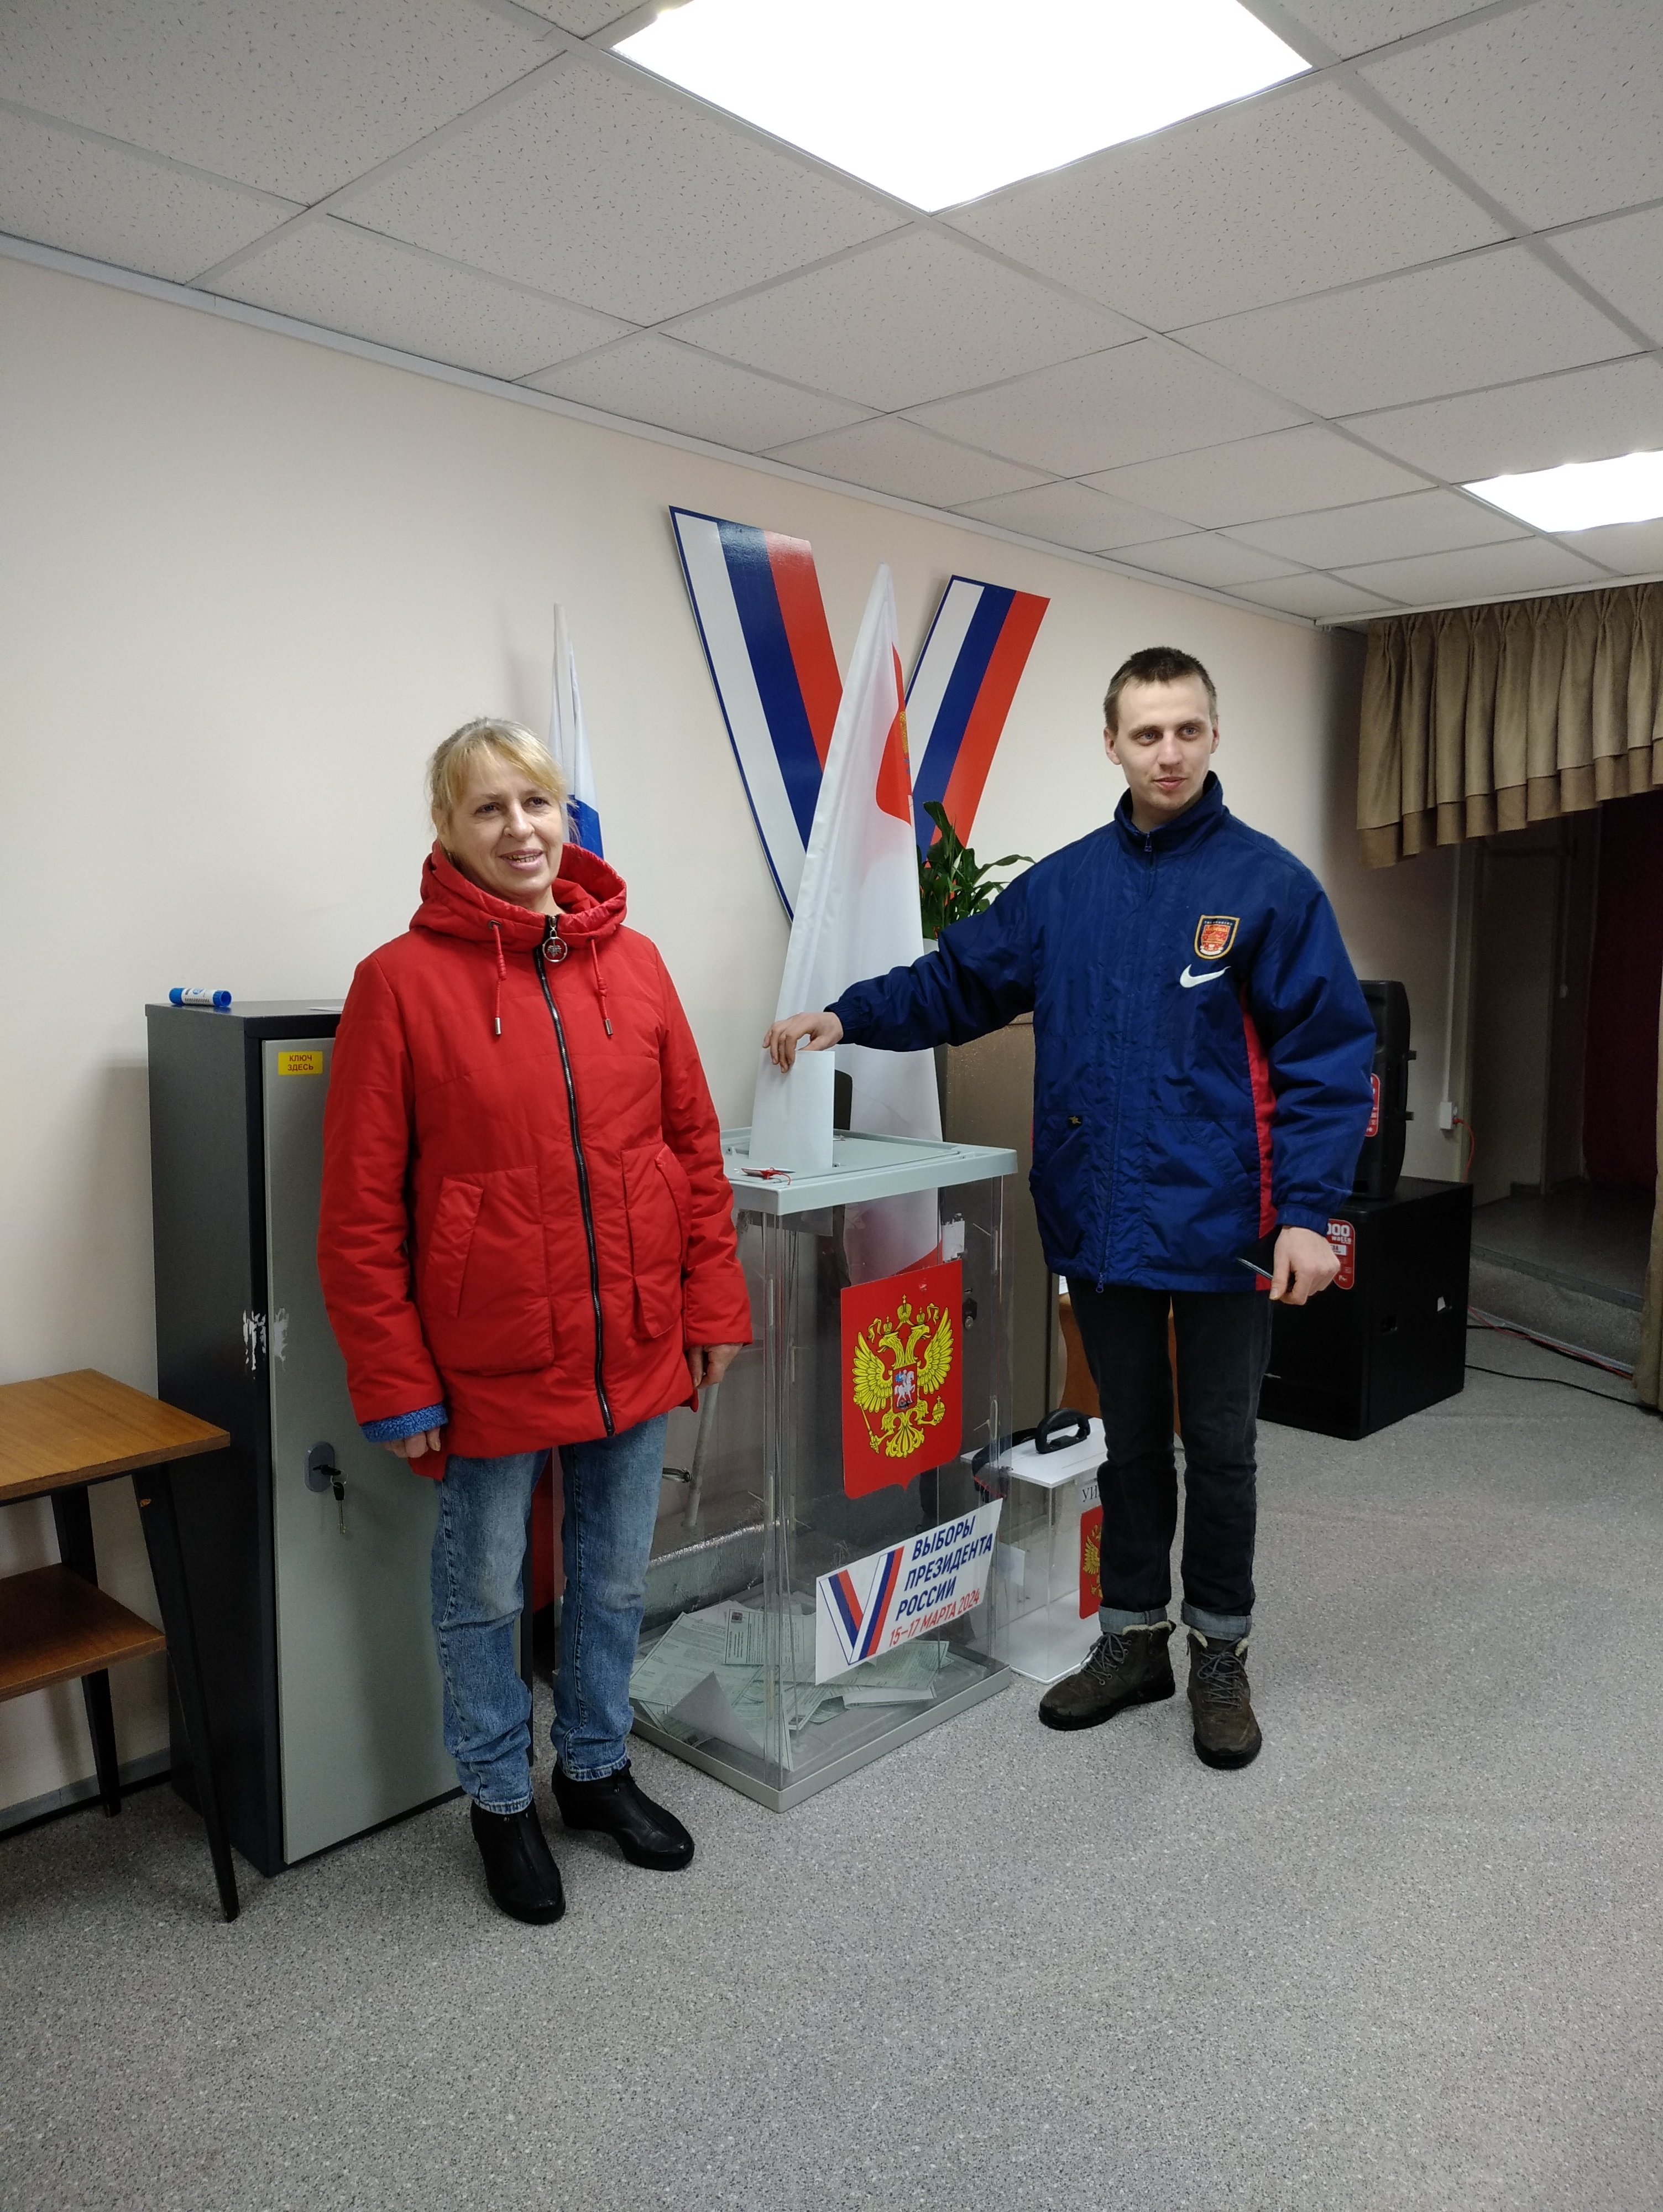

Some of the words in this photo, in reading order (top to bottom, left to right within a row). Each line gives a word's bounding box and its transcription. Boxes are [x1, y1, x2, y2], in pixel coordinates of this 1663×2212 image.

[1082, 1485, 1100, 1503] УИ
[912, 1515, 976, 1561] ВЫБОРЫ
[904, 1532, 993, 1592] ПРЕЗИДЕНТА
[895, 1575, 957, 1621] РОССИИ
[919, 1601, 956, 1632] МАРТА
[957, 1588, 980, 1615] 2024
